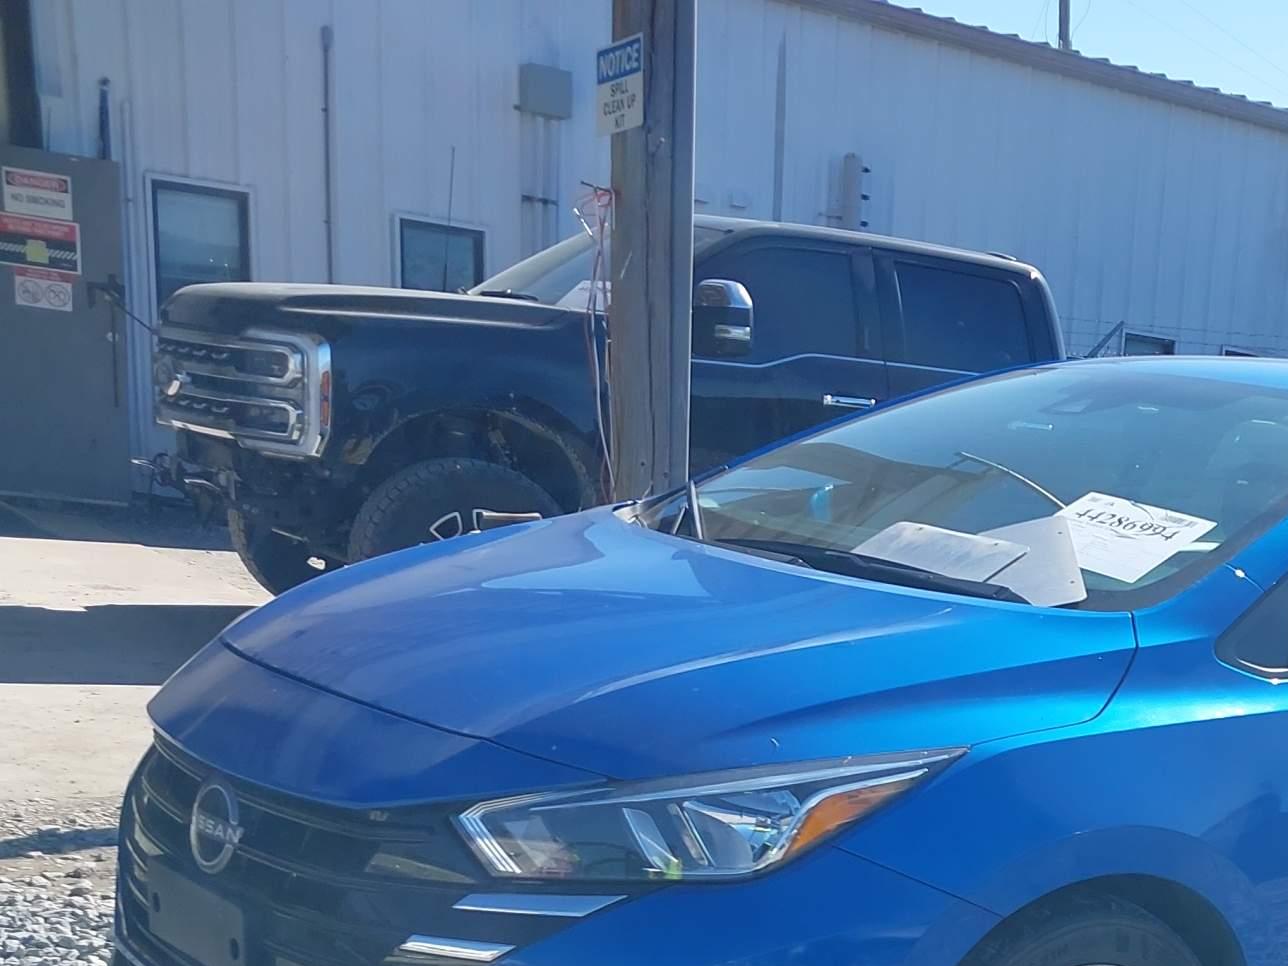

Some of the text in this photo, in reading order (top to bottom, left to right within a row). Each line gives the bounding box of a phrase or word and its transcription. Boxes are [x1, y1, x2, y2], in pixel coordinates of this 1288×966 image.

[599, 43, 640, 81] NOTICE
[1075, 508, 1180, 541] 44286994
[194, 814, 244, 844] SSAN
